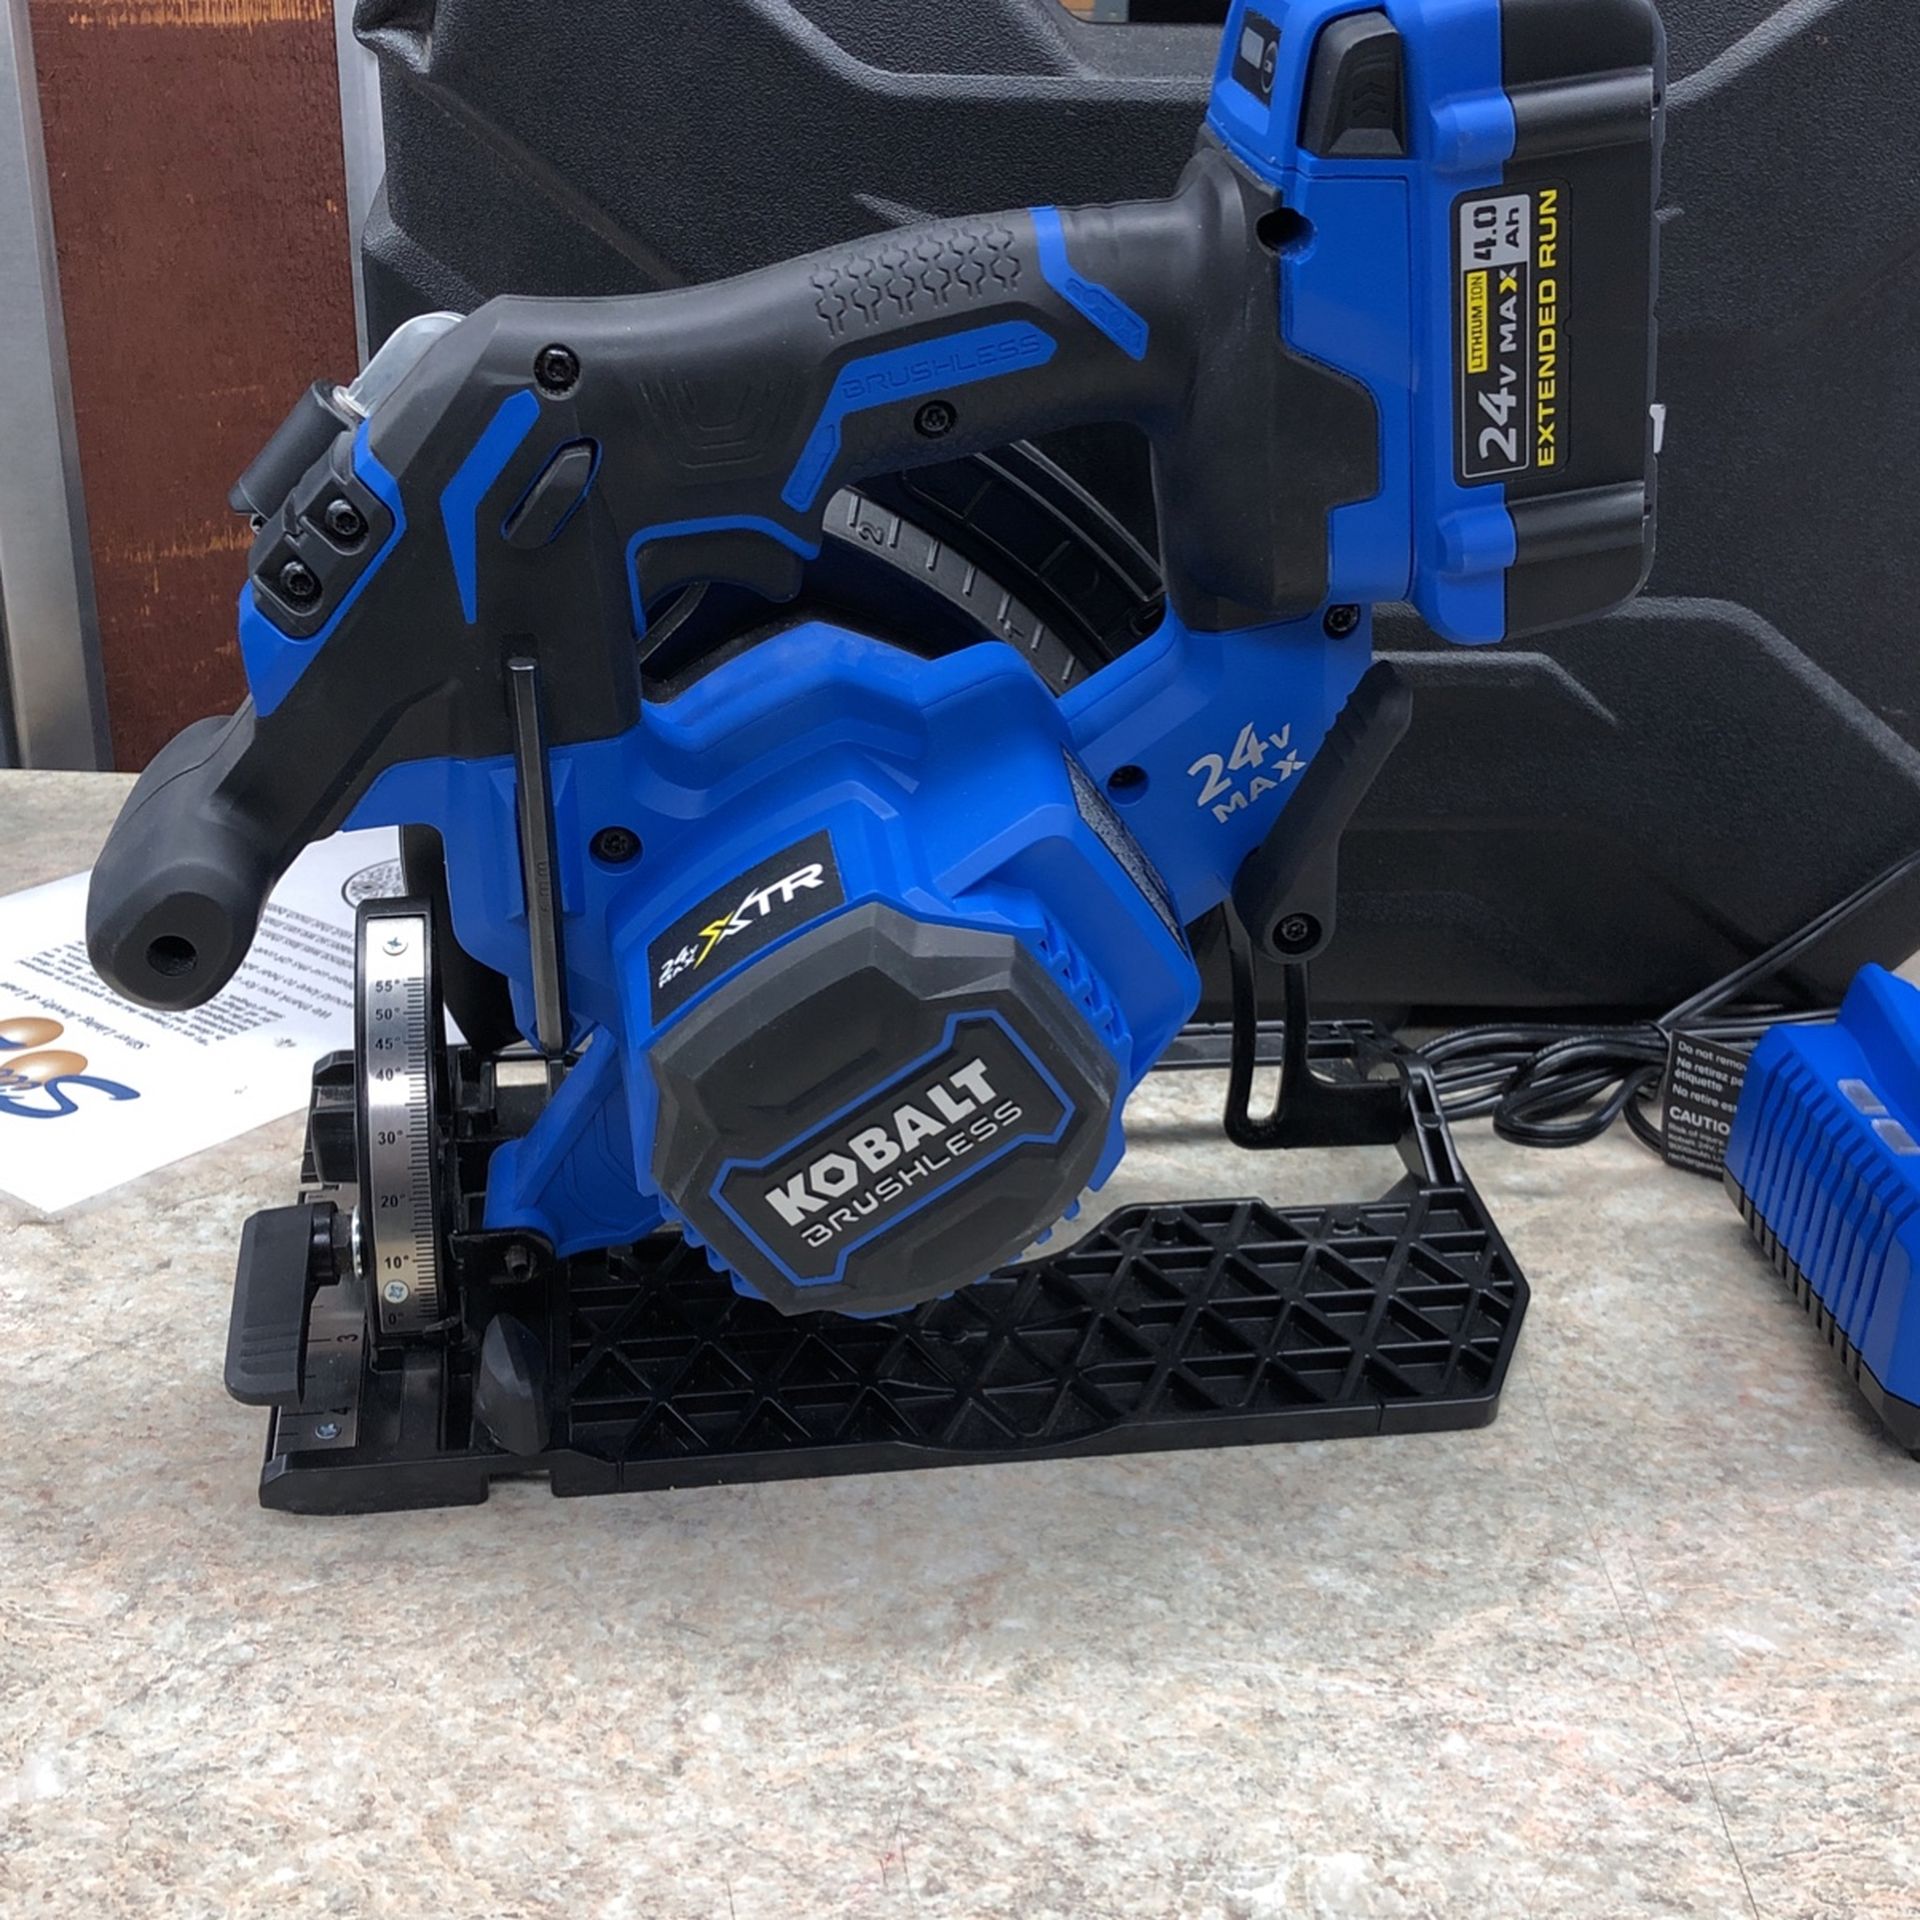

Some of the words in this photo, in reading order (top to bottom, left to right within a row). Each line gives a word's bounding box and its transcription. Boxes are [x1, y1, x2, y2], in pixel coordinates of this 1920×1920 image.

[1473, 204, 1498, 261] 4.0
[1505, 207, 1520, 248] Ah
[1539, 188, 1558, 268] RUN
[1469, 274, 1485, 300] ION
[1499, 266, 1518, 352] MAX
[1468, 303, 1485, 371] LITHIUM
[840, 333, 1042, 399] BRUSHLESS
[1537, 279, 1557, 466] EXTENDED
[1211, 749, 1307, 824] MAX
[693, 863, 825, 970] XTR
[375, 979, 400, 993] 55°
[658, 957, 698, 989] MAX
[375, 1007, 400, 1021] 50°
[375, 1036, 401, 1050] 45°
[1678, 1040, 1693, 1055] Do
[1695, 1048, 1714, 1061] not
[1716, 1055, 1748, 1072] remov
[375, 1066, 401, 1082] 40°
[1674, 1067, 1723, 1092] étiquette
[1676, 1055, 1692, 1070] Ne
[1694, 1063, 1728, 1082] retirez
[1730, 1075, 1744, 1088] pa
[1690, 1091, 1719, 1107] retire
[1721, 1101, 1737, 1114] est
[1669, 1105, 1730, 1136] CAUTIO
[378, 1130, 403, 1145] 30°
[765, 1057, 998, 1227] KOBALT
[801, 1099, 1024, 1248] BRUSHLESS
[380, 1194, 405, 1208] 20°
[384, 1255, 409, 1270] 10°
